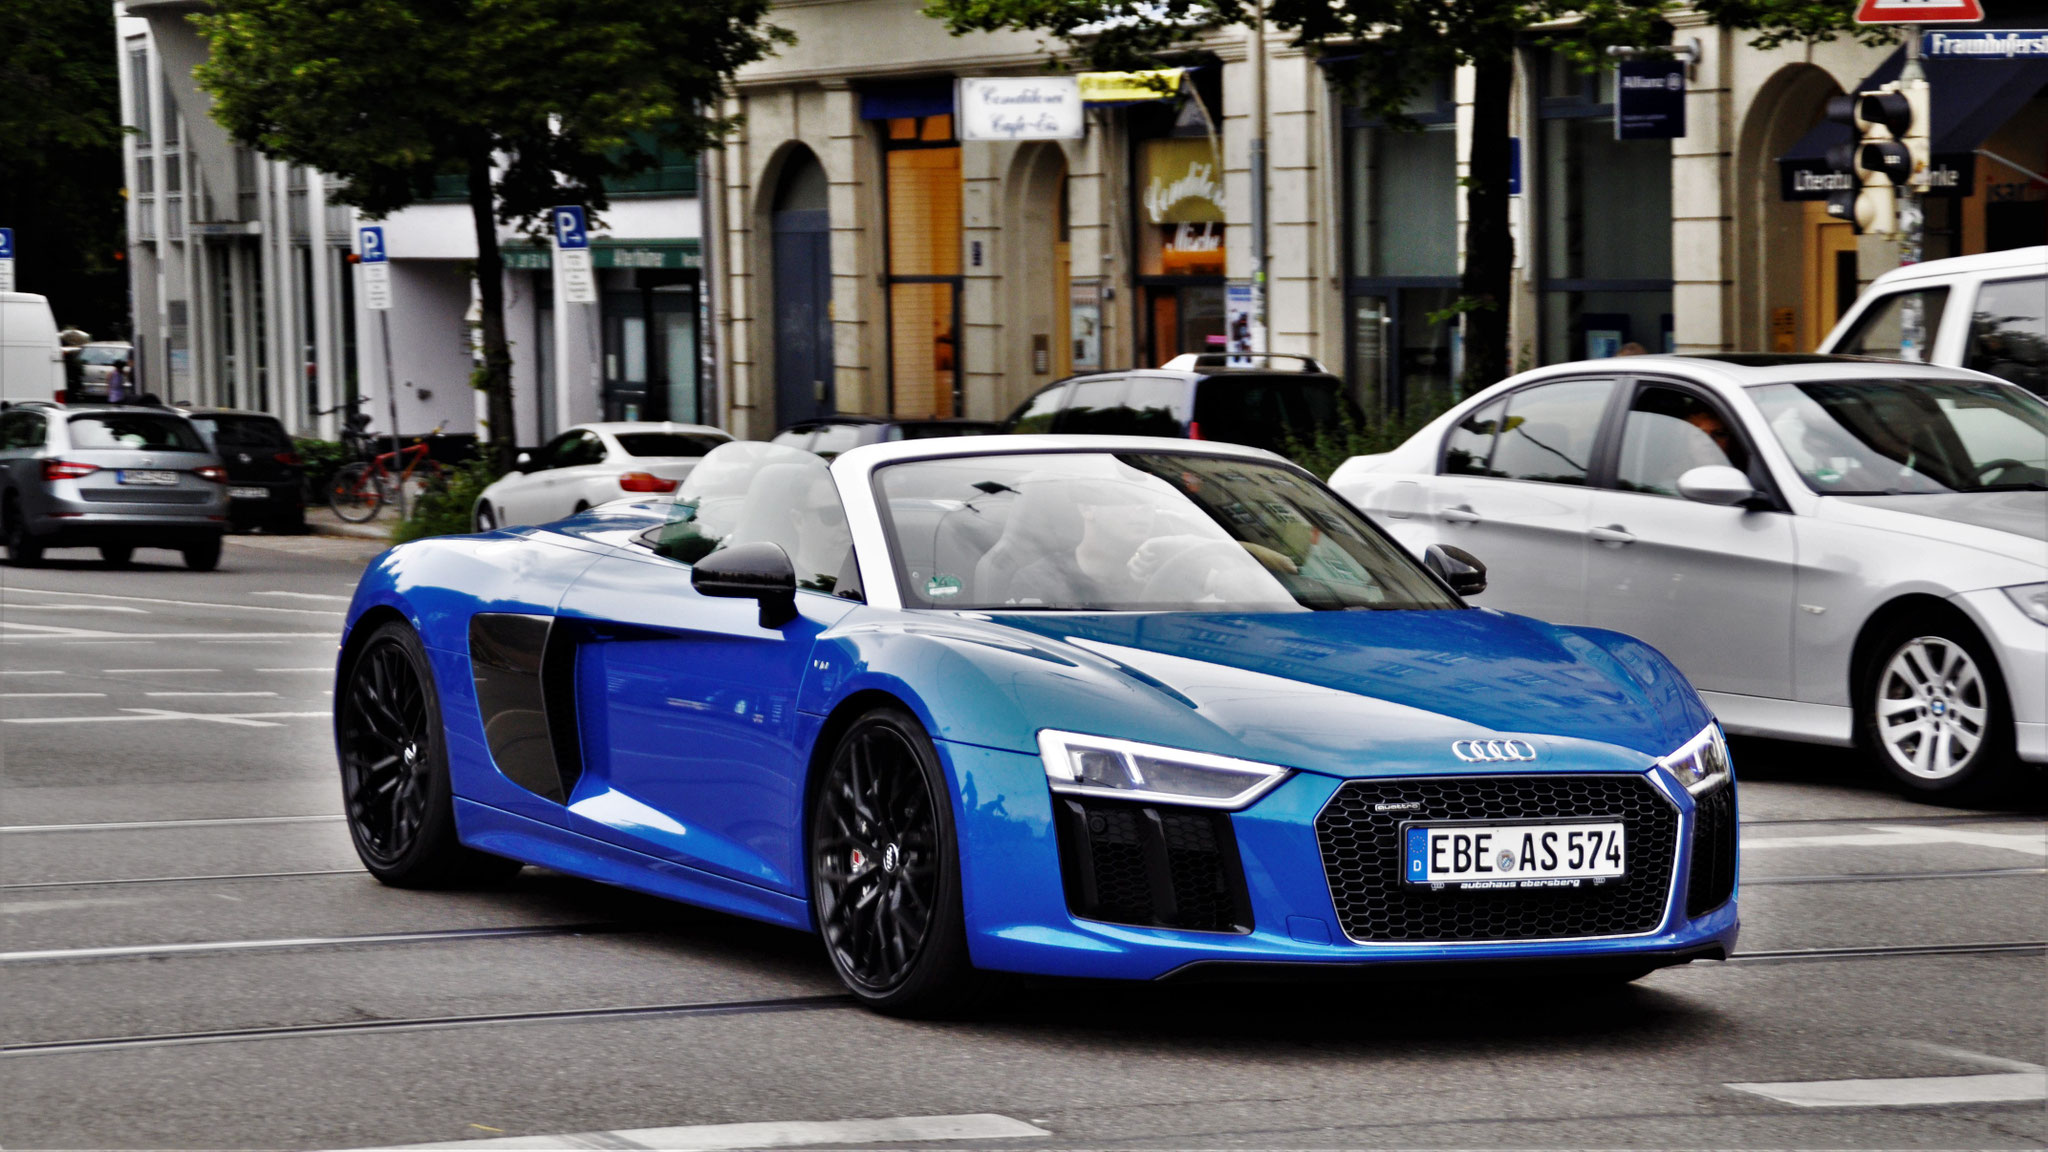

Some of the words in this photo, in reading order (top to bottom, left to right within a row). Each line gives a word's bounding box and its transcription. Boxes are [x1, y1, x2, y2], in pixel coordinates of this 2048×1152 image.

[1624, 75, 1664, 88] Allianz
[1794, 170, 1854, 191] Literatu
[557, 212, 576, 243] P
[362, 231, 379, 258] P
[1431, 834, 1493, 873] EBE
[1519, 832, 1558, 872] AS
[1568, 830, 1621, 869] 574
[1413, 860, 1421, 872] D
[1460, 881, 1516, 889] autohaus
[1520, 879, 1581, 888] ebersberg
